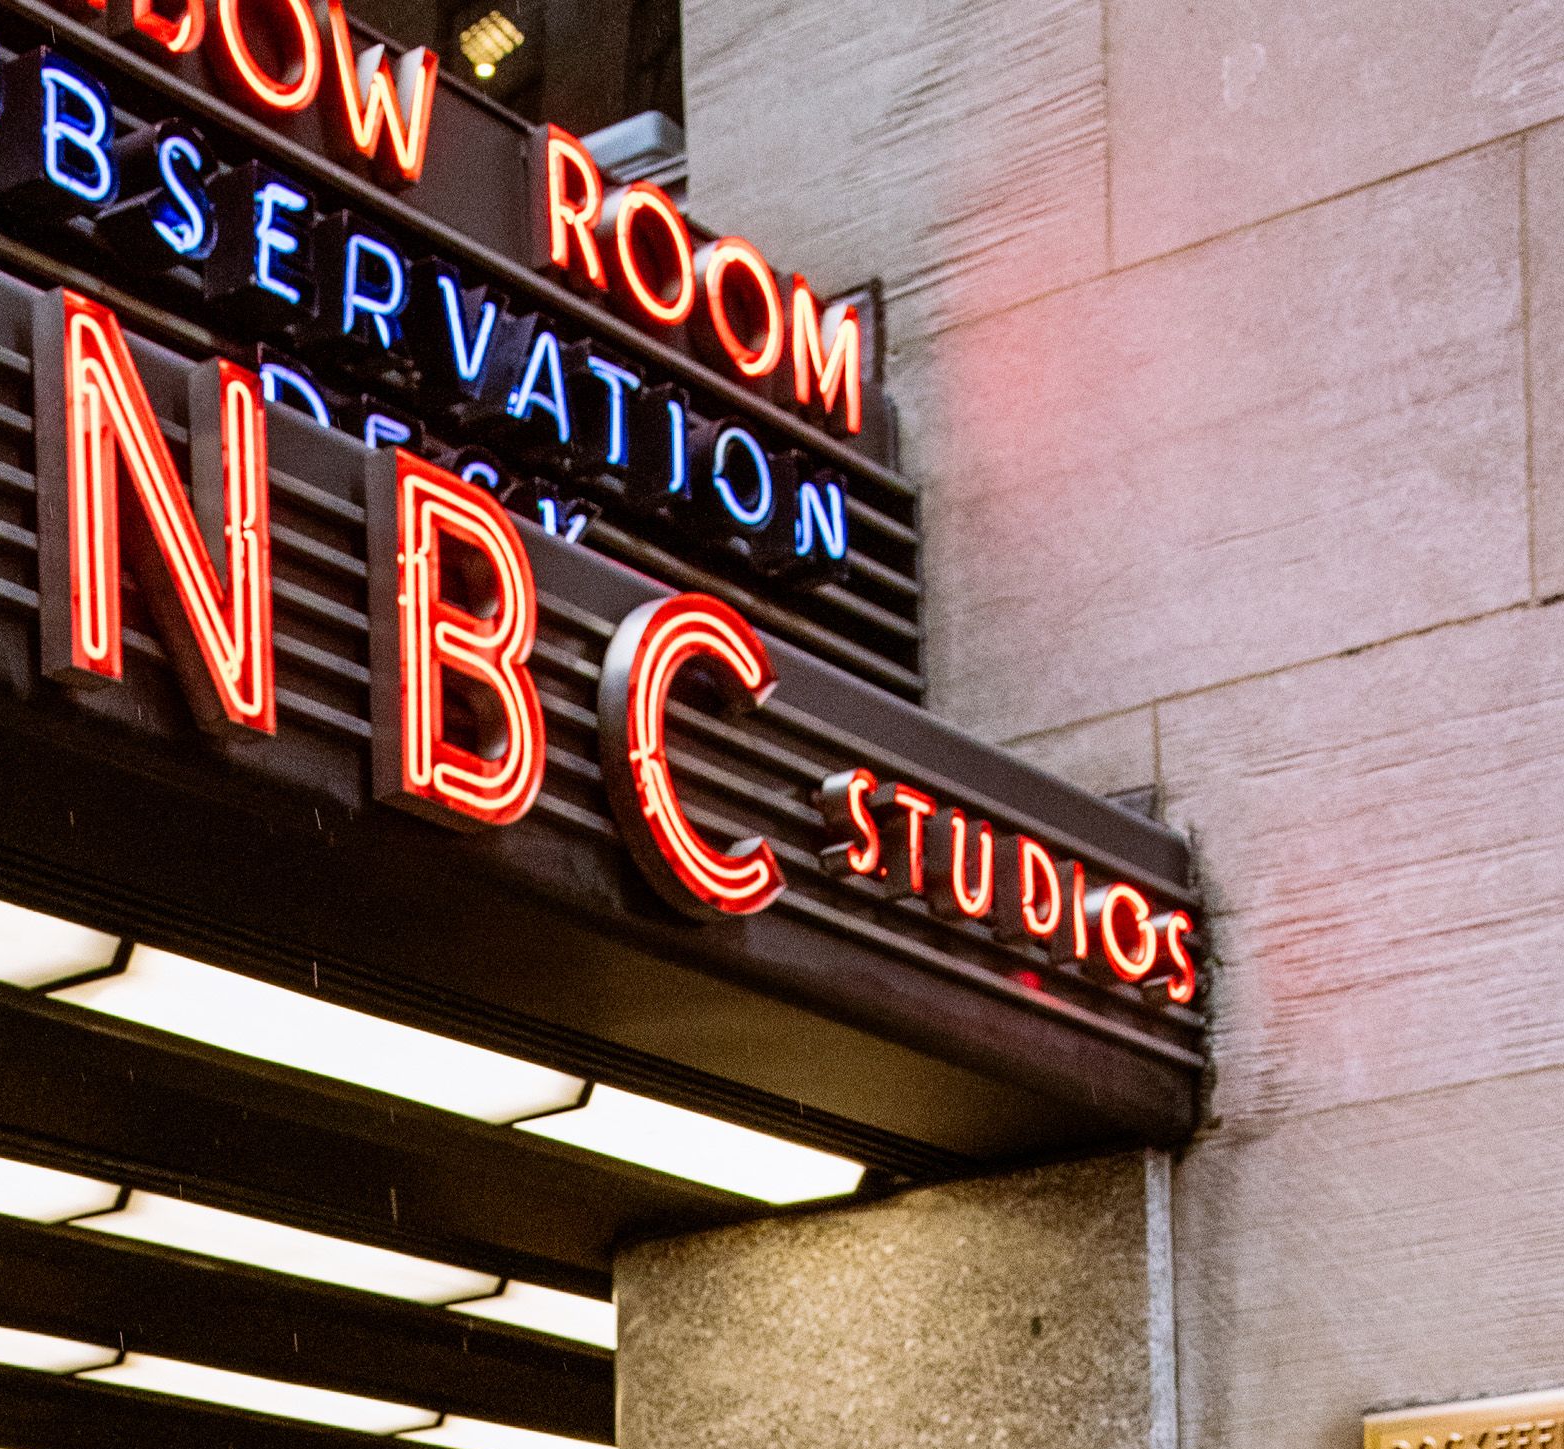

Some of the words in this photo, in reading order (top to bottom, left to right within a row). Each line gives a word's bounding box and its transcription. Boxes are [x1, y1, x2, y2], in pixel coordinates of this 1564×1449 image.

[543, 122, 861, 433] ROOM
[52, 286, 788, 915] NBC
[844, 767, 1197, 1003] STUDIOS
